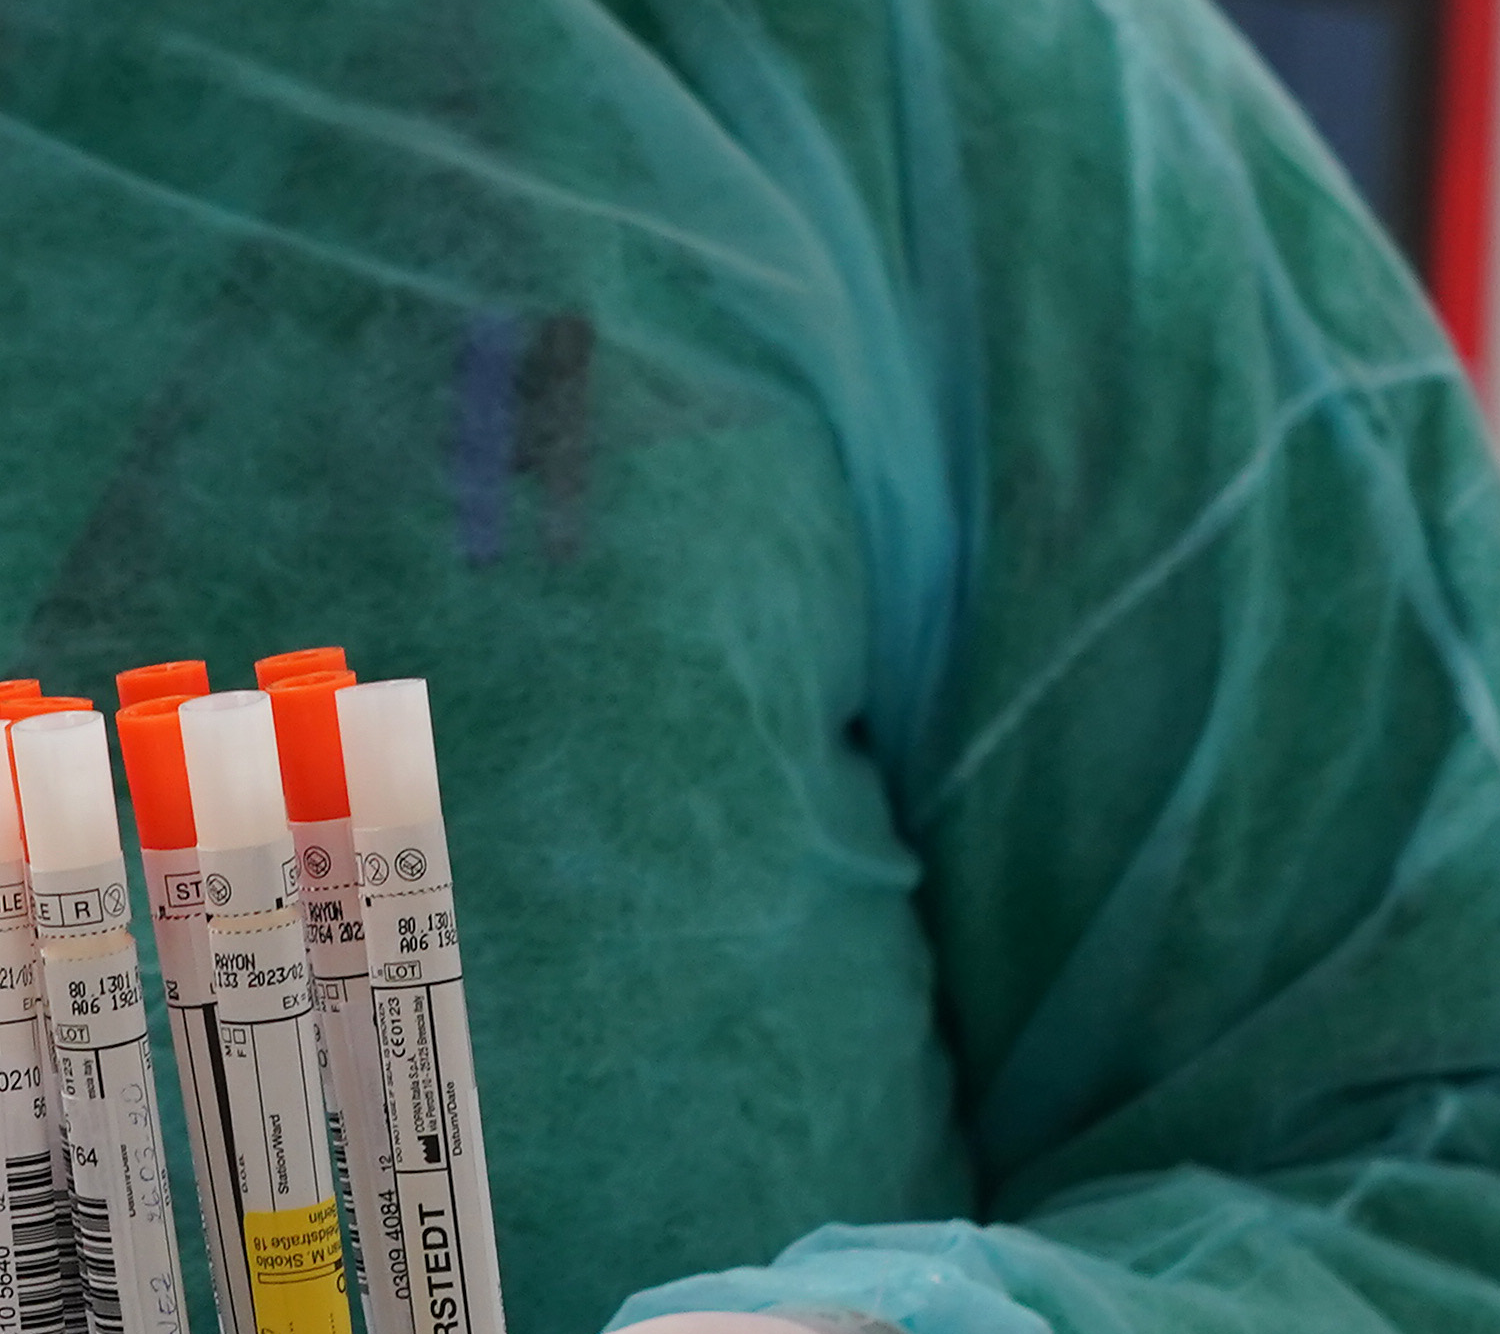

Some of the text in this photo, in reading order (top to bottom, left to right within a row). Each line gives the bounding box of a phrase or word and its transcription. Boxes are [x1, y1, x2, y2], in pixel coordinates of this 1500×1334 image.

[74, 900, 91, 920] R
[400, 934, 429, 954] A06
[214, 952, 256, 971] RAYON
[388, 965, 418, 980] LOT
[71, 997, 100, 1017] A06
[446, 1081, 463, 1157] Datum/Date
[378, 1154, 393, 1172] 12
[253, 1237, 268, 1252] 18
[256, 1253, 304, 1270] Skoblo
